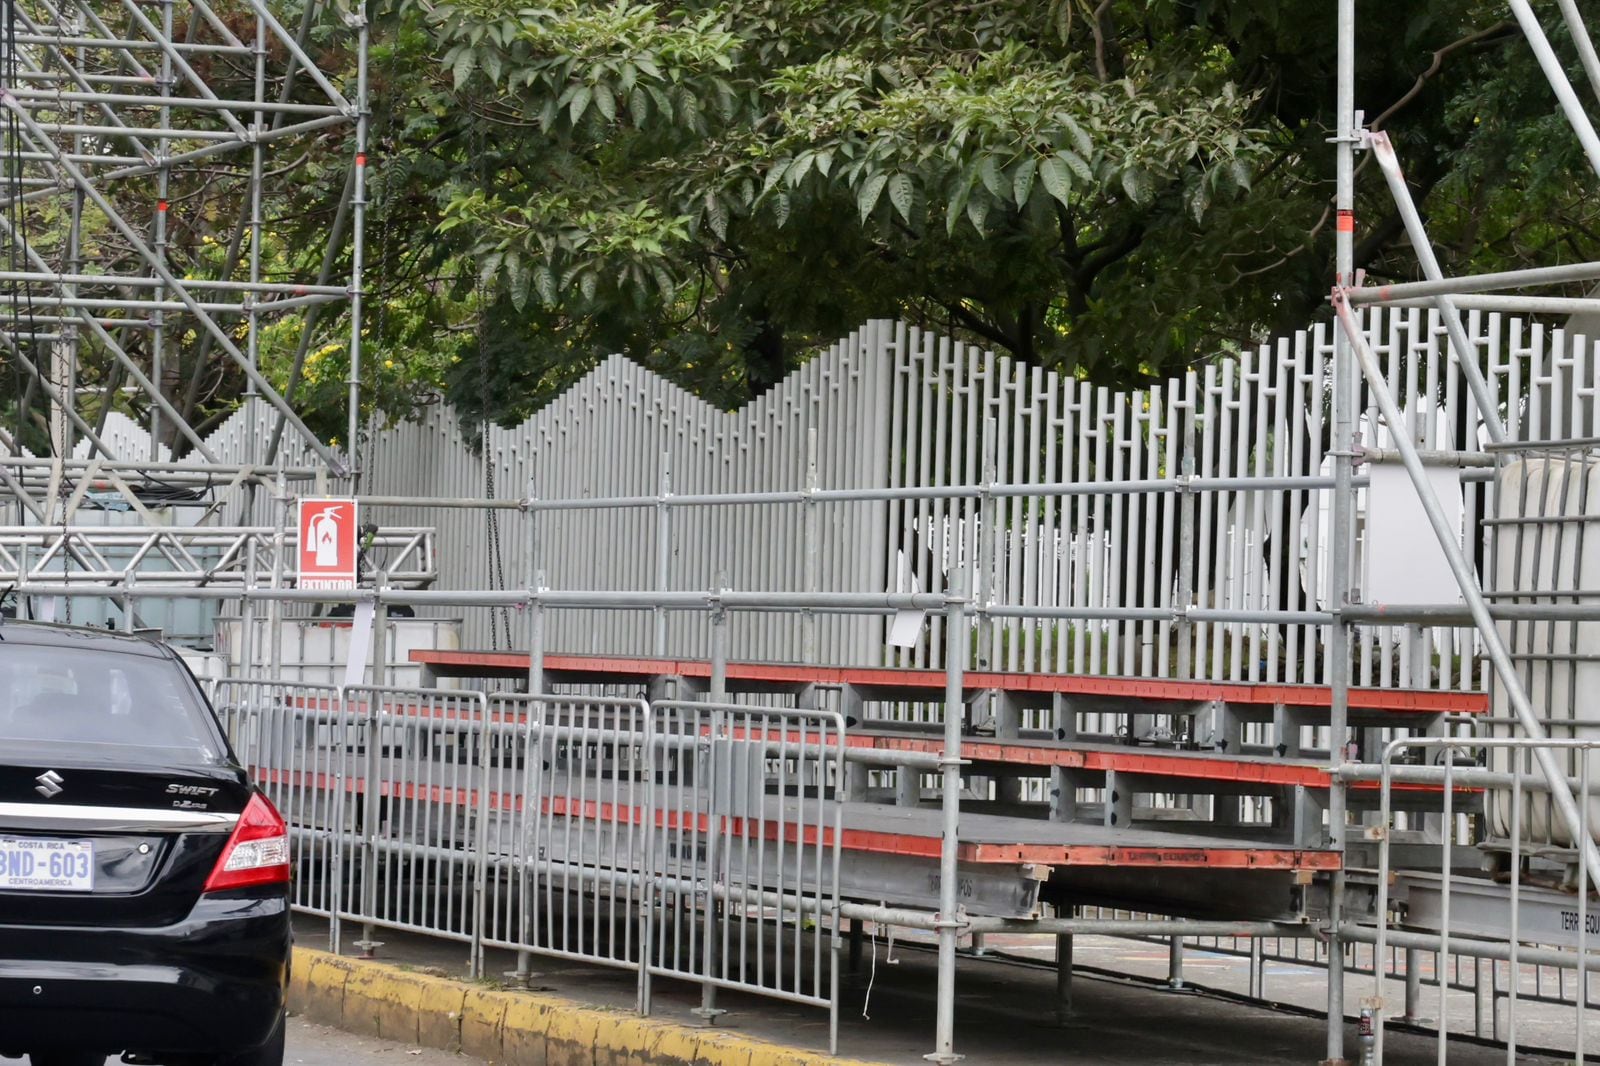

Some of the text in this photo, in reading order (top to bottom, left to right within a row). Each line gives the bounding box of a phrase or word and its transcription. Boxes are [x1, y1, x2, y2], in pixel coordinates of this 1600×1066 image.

[165, 783, 220, 797] SWIFT
[18, 841, 65, 850] COSTA RICA
[8, 878, 73, 886] CENTROAMERICA
[1561, 911, 1579, 932] TERR
